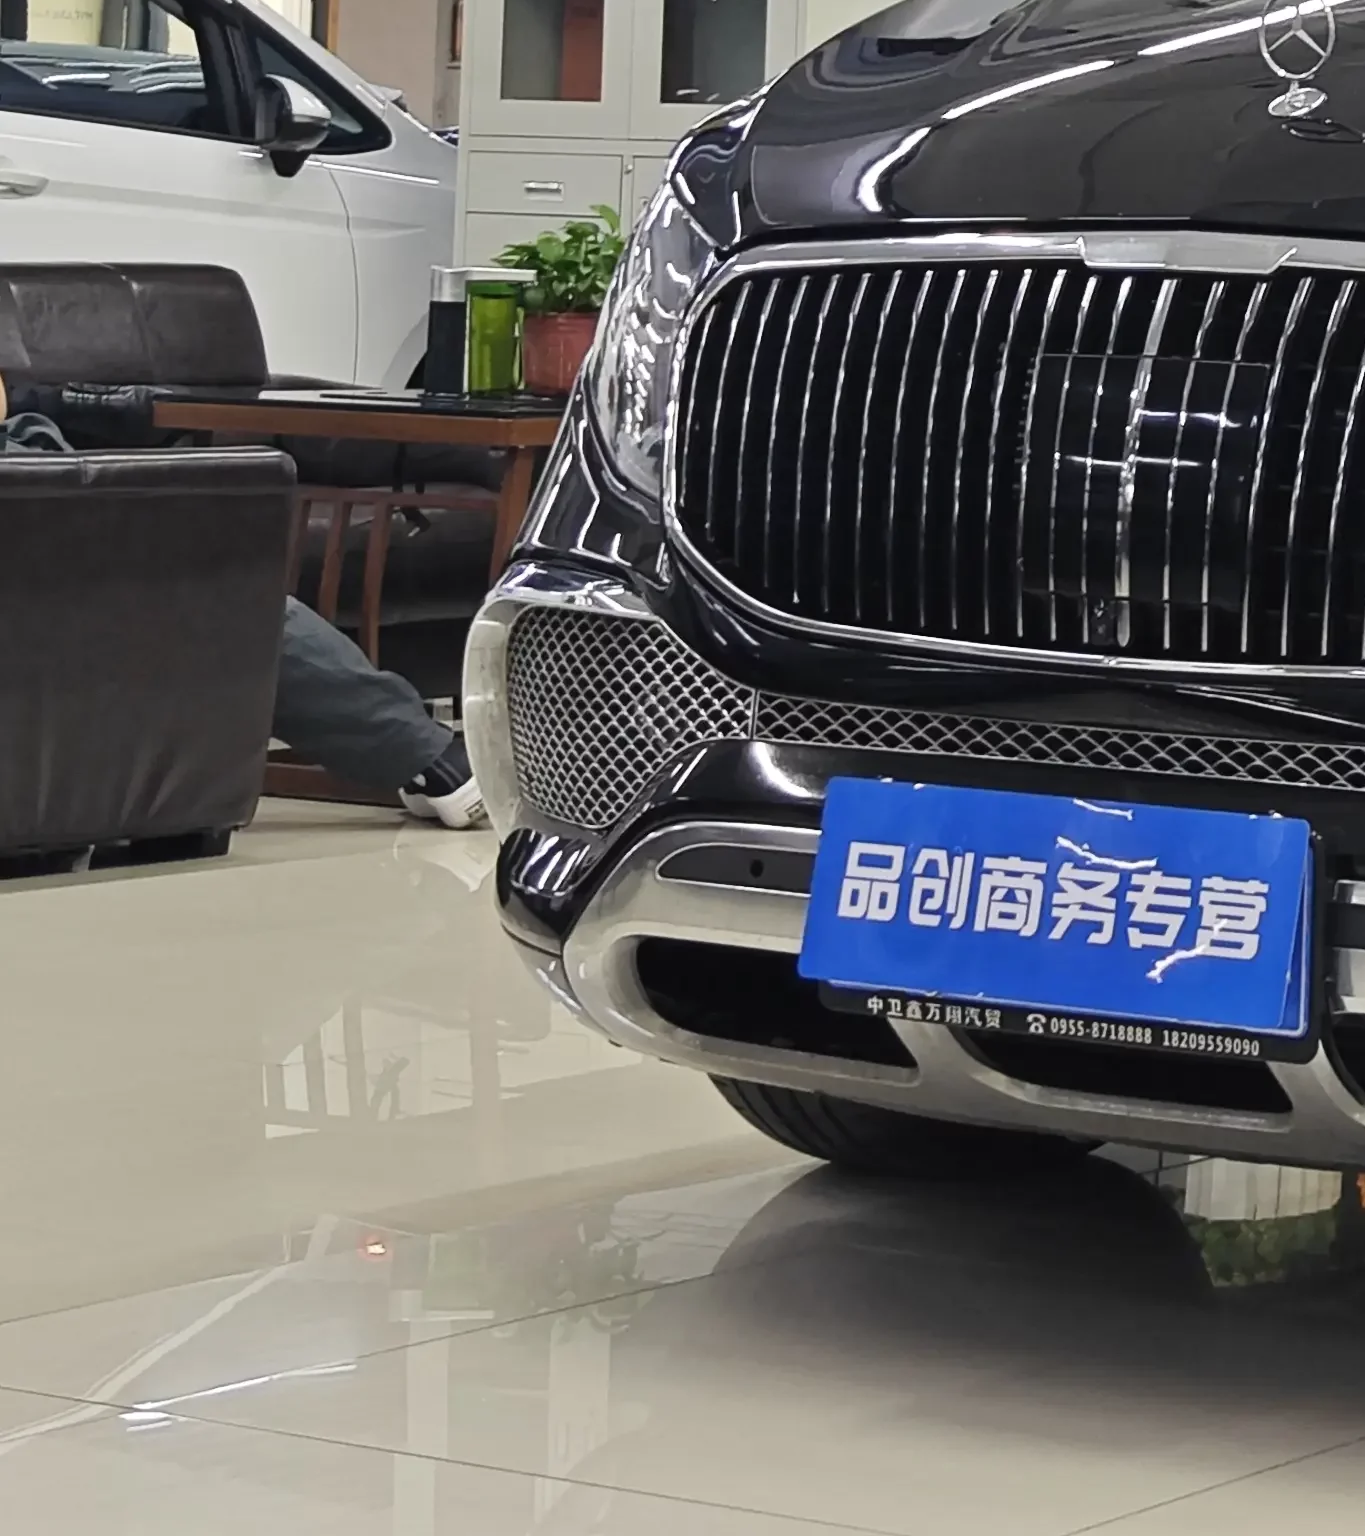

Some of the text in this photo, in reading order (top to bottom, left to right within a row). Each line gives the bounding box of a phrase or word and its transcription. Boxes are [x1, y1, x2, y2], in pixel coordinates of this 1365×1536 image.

[836, 840, 1271, 962] 品创商务专营
[1049, 1016, 1153, 1045] 0955-8718888
[1162, 1029, 1260, 1057] 18209559090
